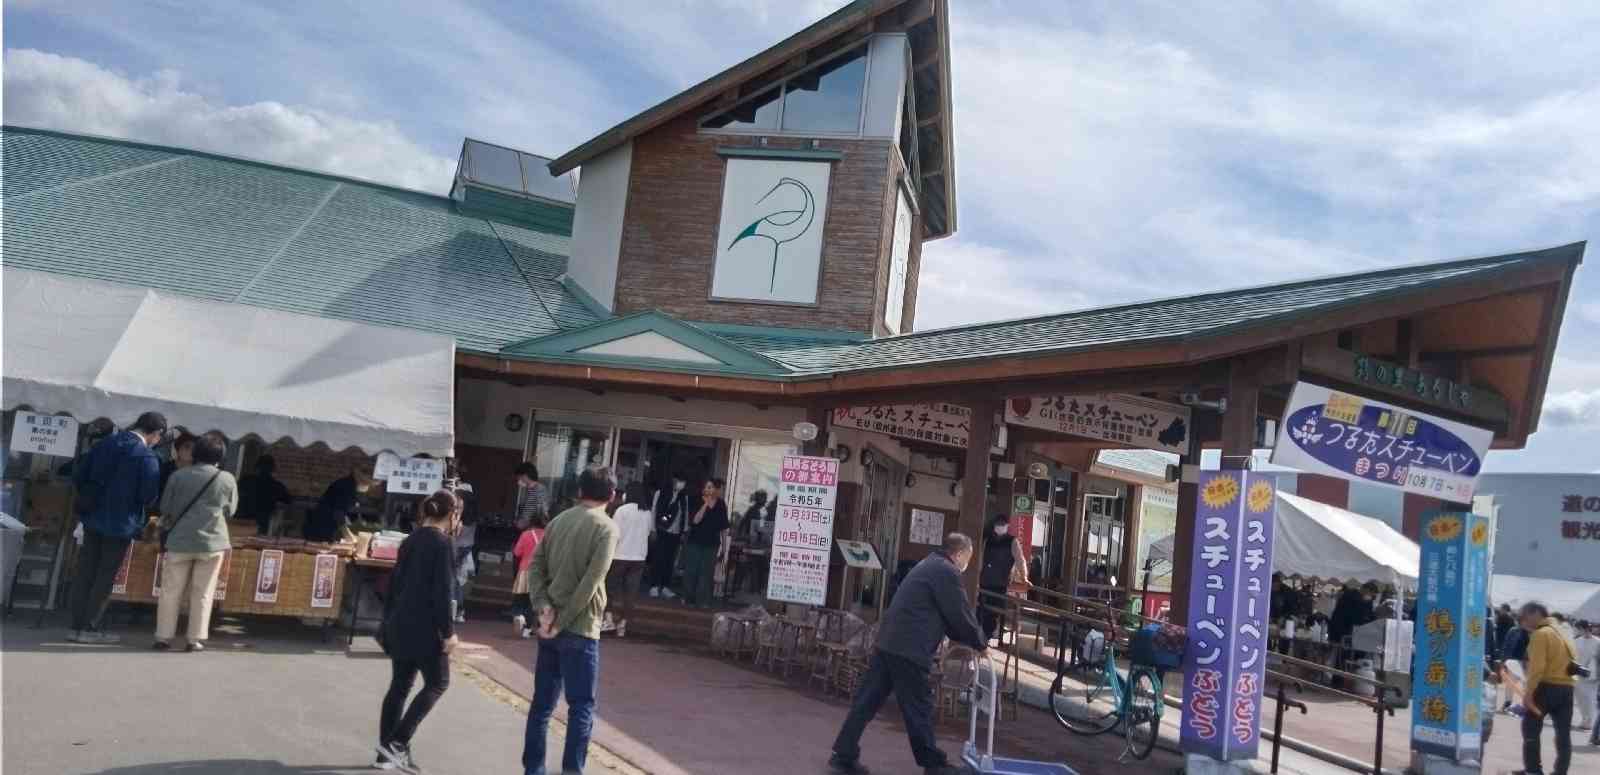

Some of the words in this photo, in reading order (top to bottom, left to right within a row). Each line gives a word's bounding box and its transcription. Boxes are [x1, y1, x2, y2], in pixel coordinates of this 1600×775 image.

[1326, 422, 1474, 473] つるたスチューベン
[789, 494, 823, 508] 令和5年
